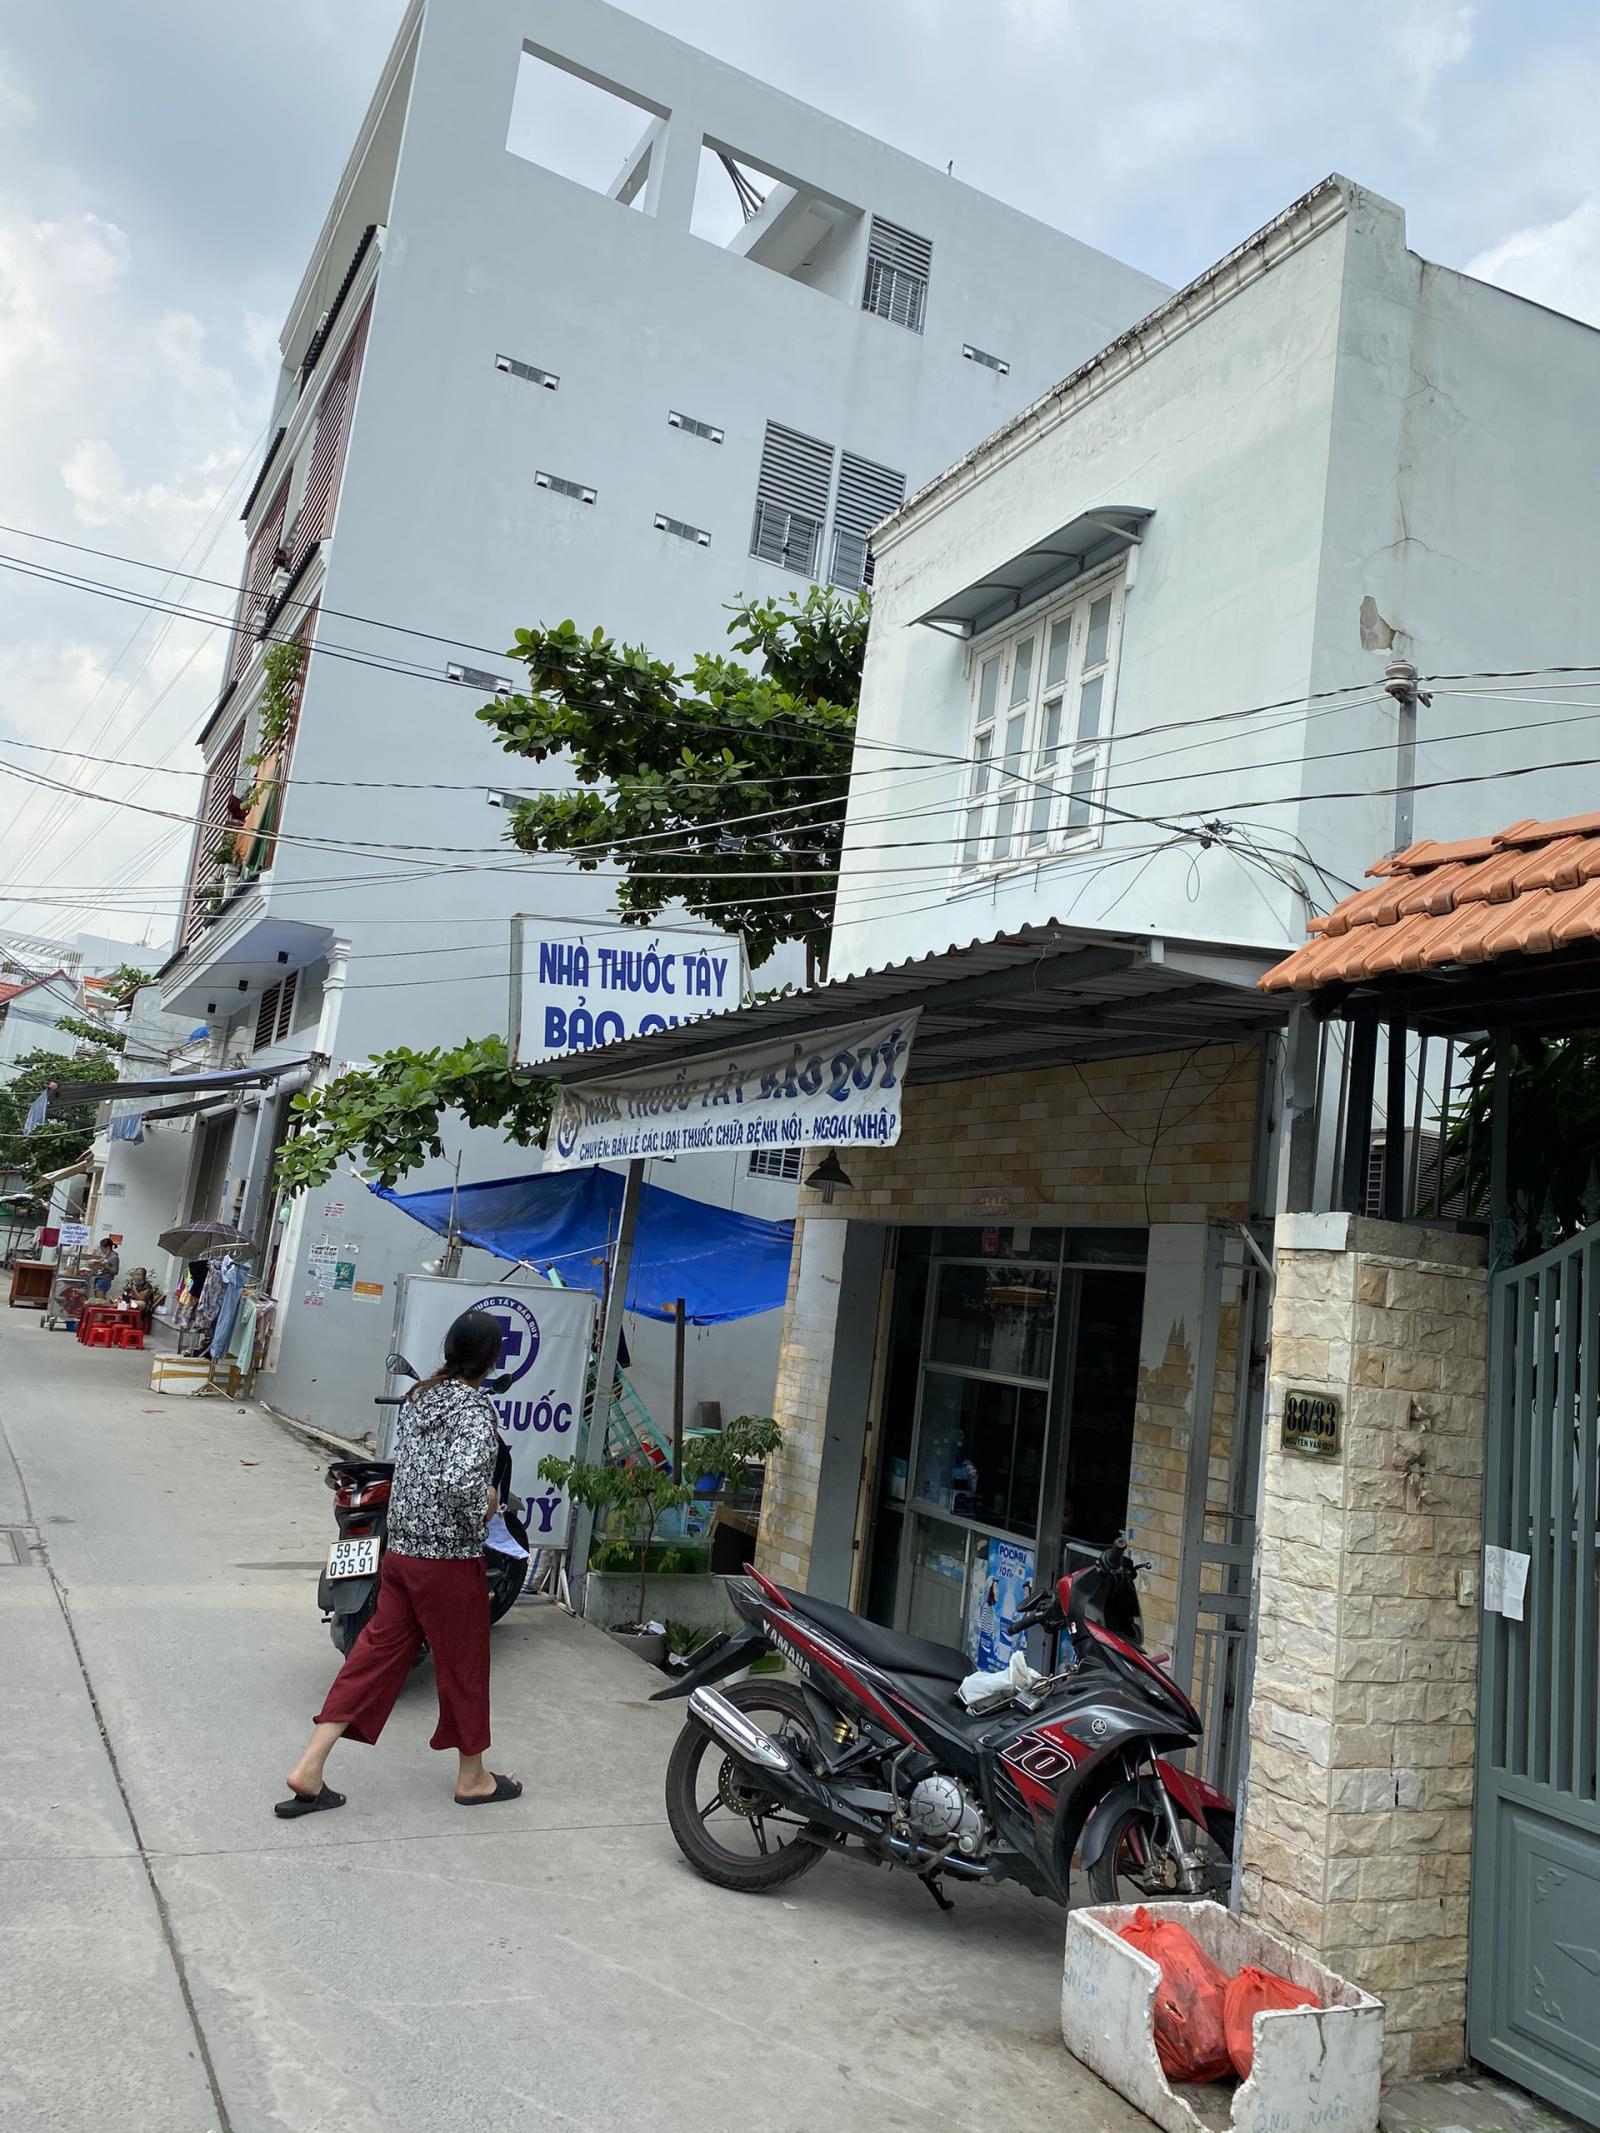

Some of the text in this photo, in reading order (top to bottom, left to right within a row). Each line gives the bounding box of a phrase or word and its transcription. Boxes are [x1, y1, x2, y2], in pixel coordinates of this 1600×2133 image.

[539, 936, 728, 997] NHÀ THUỐC TÂY
[544, 996, 625, 1050] BẢO
[826, 1028, 908, 1102] QUÝ
[611, 1130, 629, 1155] BÁN
[641, 1127, 658, 1151] CÁC
[660, 1130, 681, 1153] LOẠI
[683, 1118, 714, 1148] THUỐC
[715, 1118, 744, 1145] CHỮA
[746, 1115, 778, 1147] BỆNH
[781, 1112, 802, 1146] NỘI
[812, 1113, 852, 1143] NGOẠI
[855, 1107, 896, 1144] NHẬP
[494, 1389, 573, 1433] HUỐC
[330, 1556, 374, 1577] 035.91
[336, 1540, 373, 1559] 59-F2
[999, 1545, 1027, 1564] POCARI
[762, 1619, 811, 1678] YAMAHA
[1002, 1734, 1071, 1779] 10
